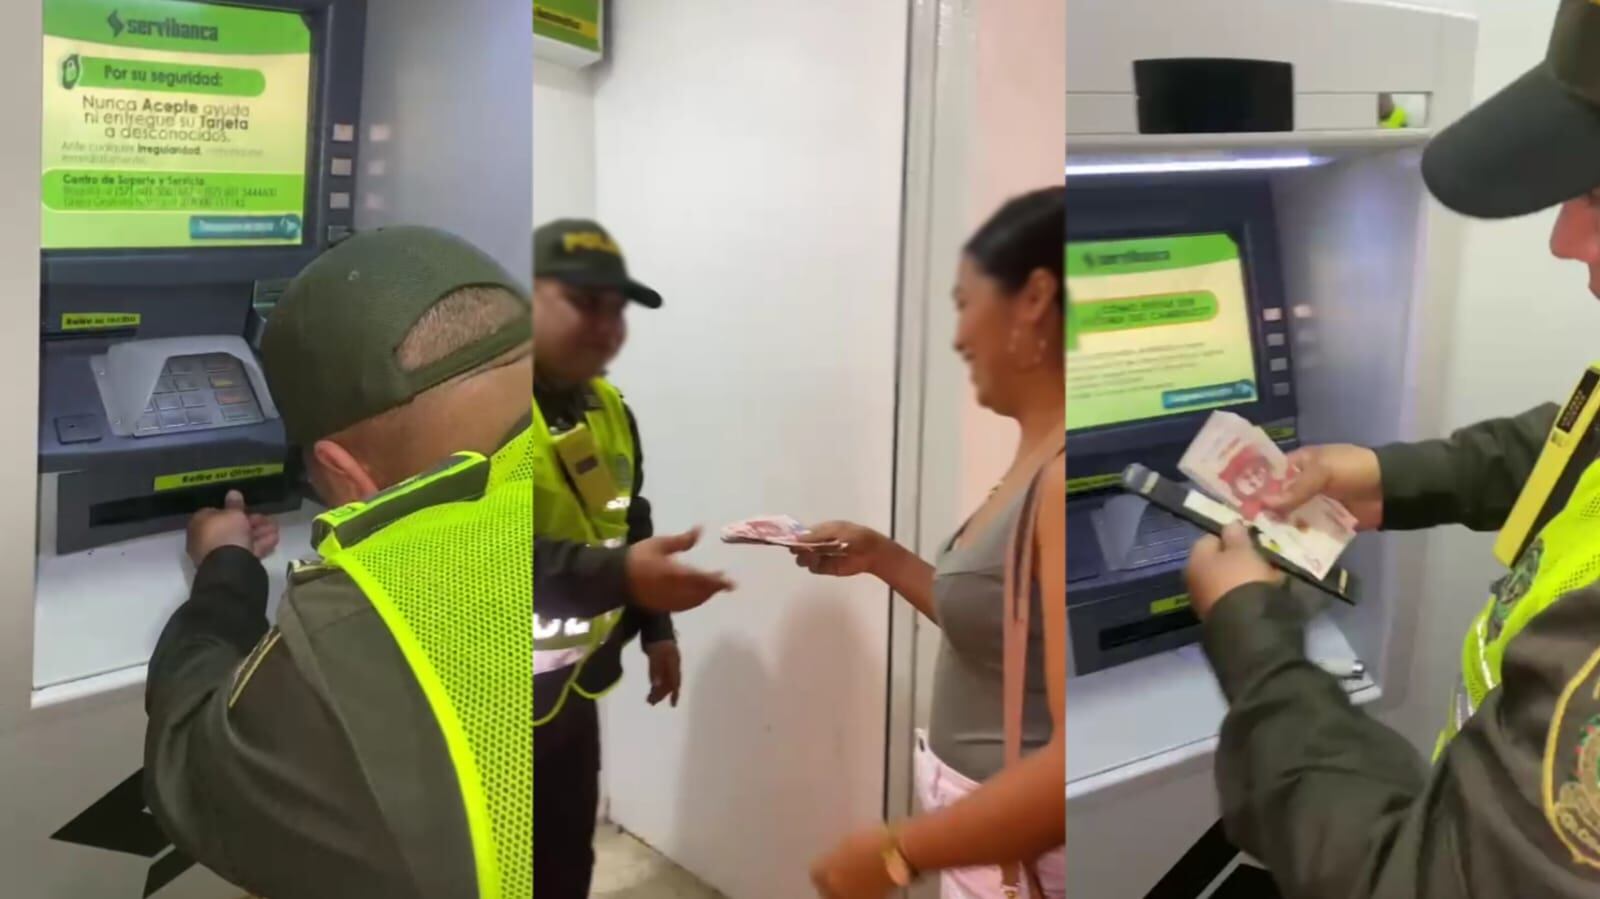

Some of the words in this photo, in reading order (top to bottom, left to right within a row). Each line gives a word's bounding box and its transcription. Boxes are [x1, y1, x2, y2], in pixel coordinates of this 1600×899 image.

[126, 18, 219, 42] servibanca
[103, 65, 127, 81] Por
[131, 70, 147, 82] su
[151, 68, 223, 88] seguridad:
[82, 95, 137, 111] Nunca
[142, 98, 199, 115] Acepte
[203, 103, 250, 117] ayuda
[84, 111, 99, 124] ni
[103, 112, 175, 130] entregue
[180, 116, 196, 128] su
[200, 115, 249, 131] Tarjeta
[104, 127, 116, 139] a
[120, 127, 231, 143] desconocidos.
[63, 174, 98, 184] Centro
[101, 173, 115, 184] de
